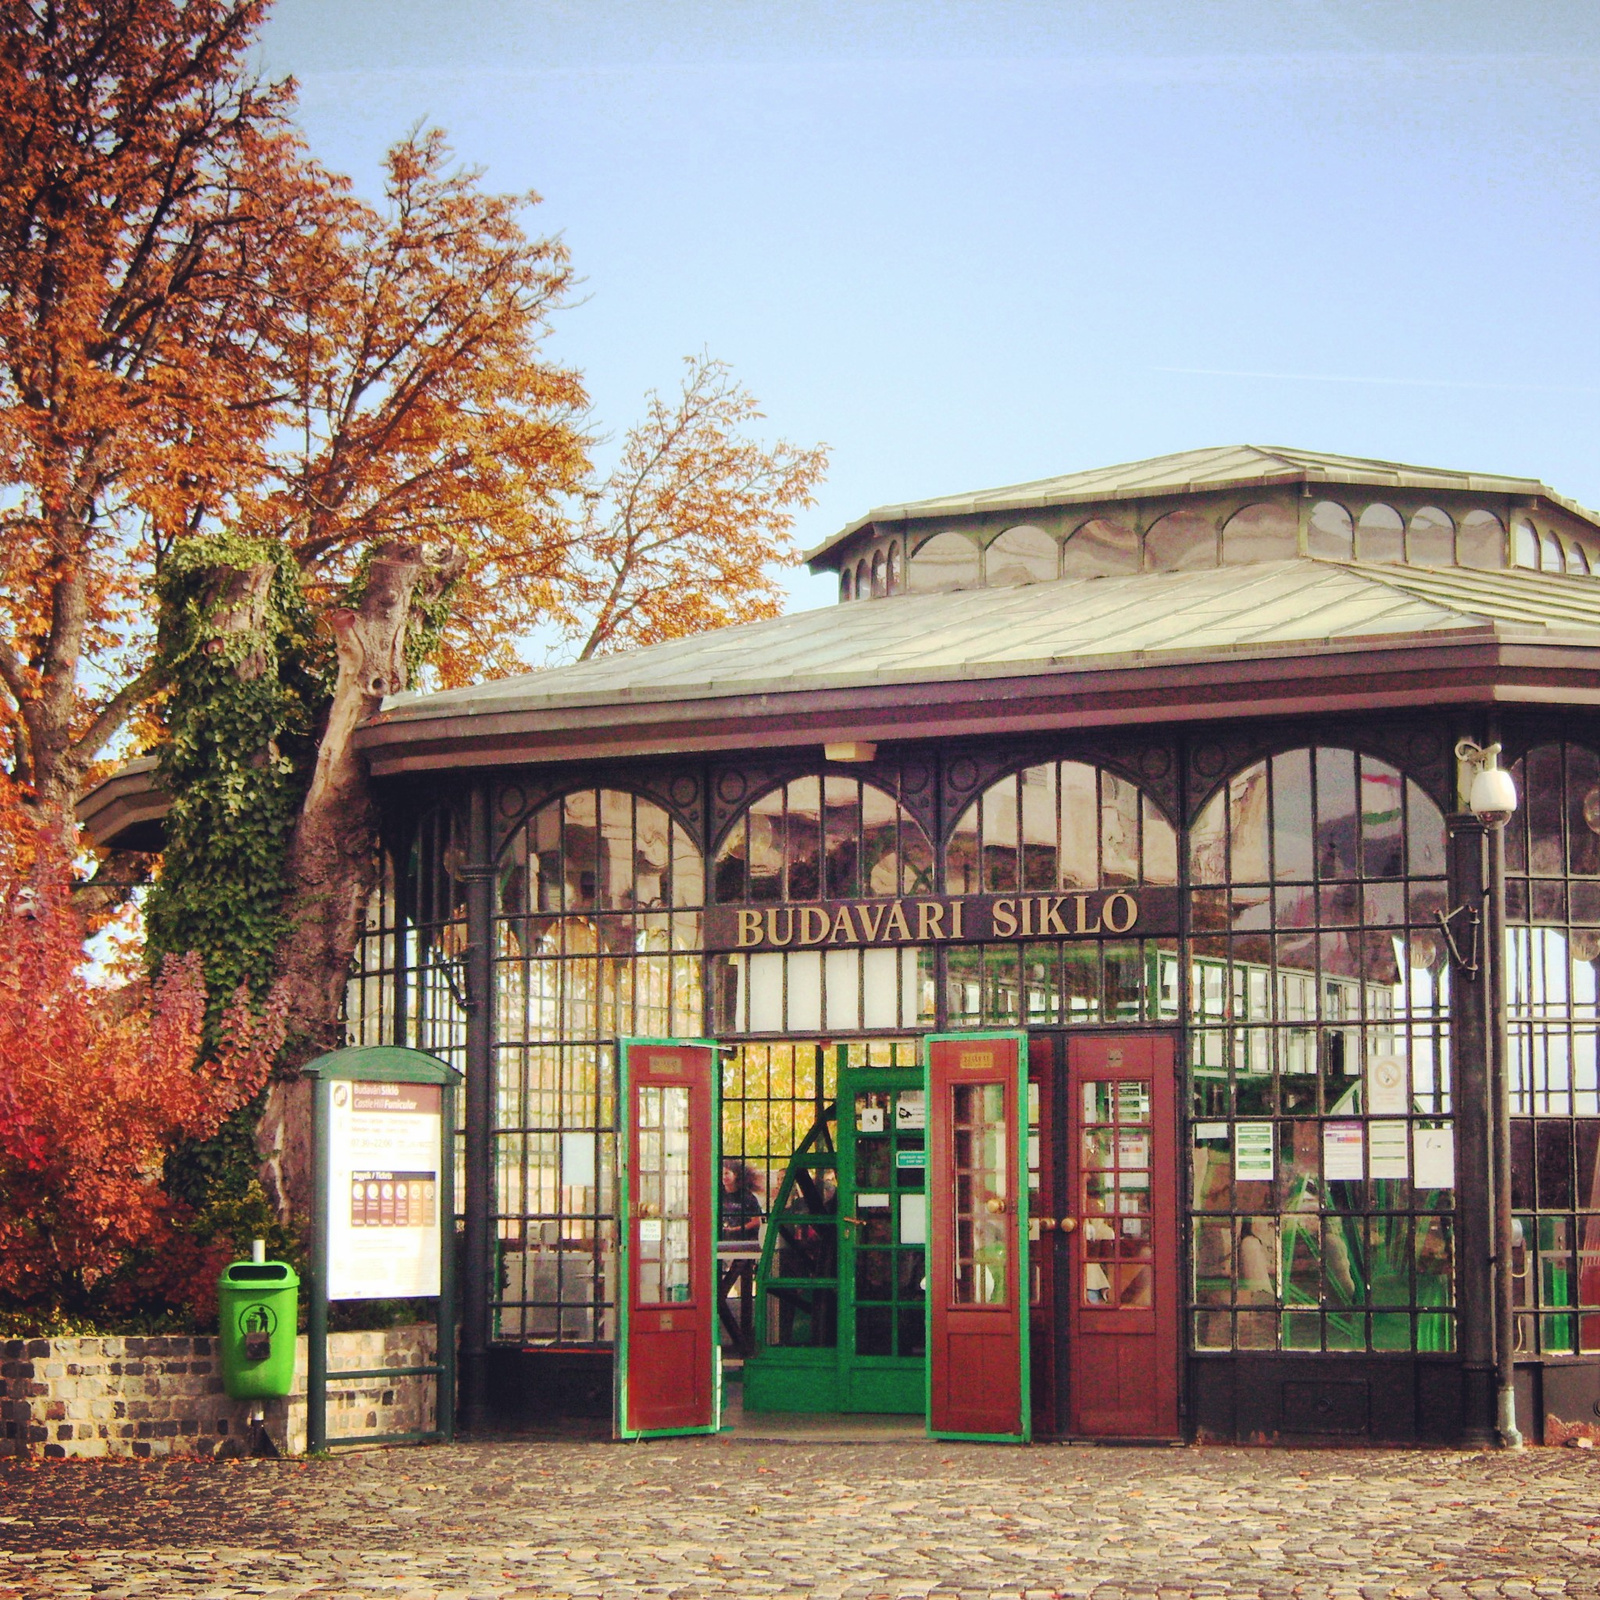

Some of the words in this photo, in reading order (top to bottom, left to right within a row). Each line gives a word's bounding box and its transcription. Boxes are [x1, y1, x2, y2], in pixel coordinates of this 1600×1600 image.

[736, 900, 965, 947] BUDAVÁRI
[992, 890, 1138, 938] SIKLÓ
[354, 1098, 373, 1109] Castle
[373, 1099, 384, 1109] Hill
[384, 1099, 417, 1110] Funicular
